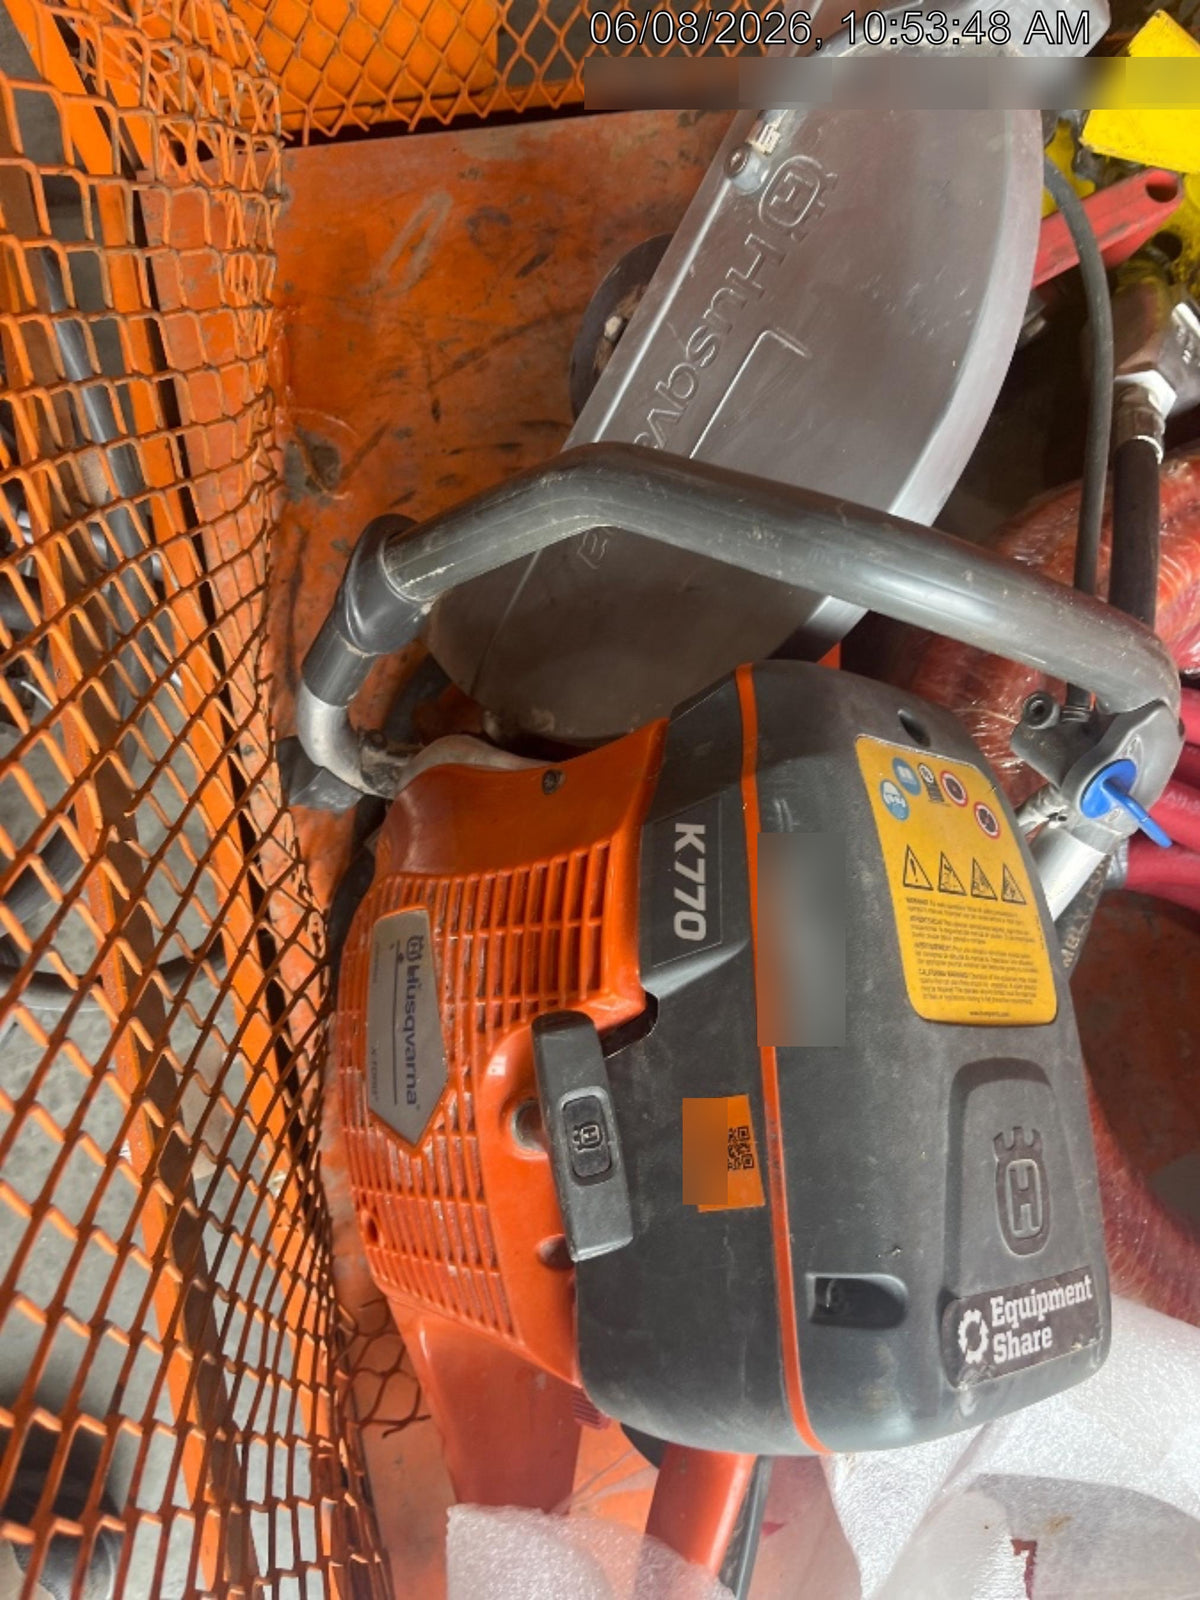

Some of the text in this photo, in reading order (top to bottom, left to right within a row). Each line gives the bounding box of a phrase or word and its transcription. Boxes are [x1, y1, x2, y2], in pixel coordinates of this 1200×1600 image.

[674, 822, 707, 942] K770
[401, 965, 419, 1105] Husqvarna
[990, 1274, 1093, 1329] Equipment
[993, 1325, 1053, 1364] Share
